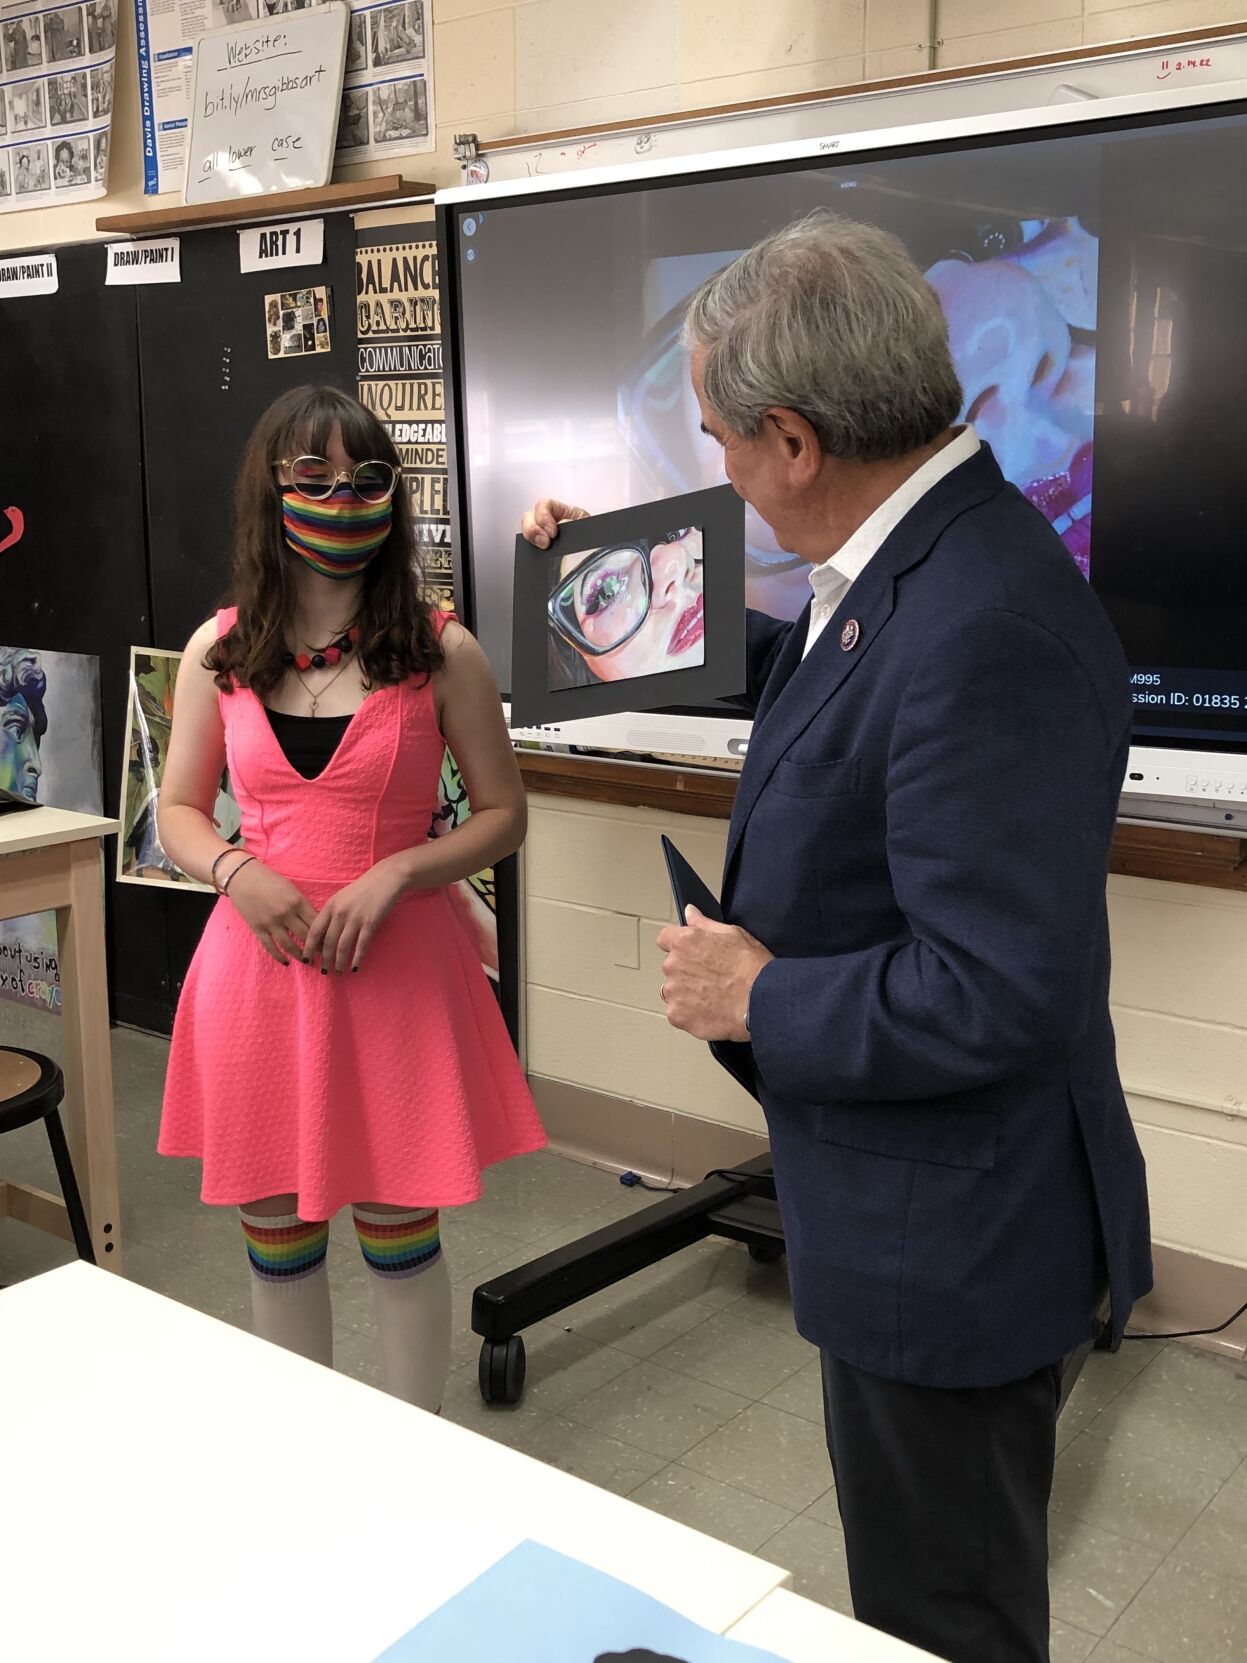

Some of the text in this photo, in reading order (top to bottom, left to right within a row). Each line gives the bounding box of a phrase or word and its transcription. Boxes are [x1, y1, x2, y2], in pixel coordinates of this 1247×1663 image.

[226, 34, 287, 65] Website:
[140, 60, 151, 116] Drawing
[203, 65, 326, 118] bit.ly/mrsgibbsart
[144, 120, 153, 157] Davis
[819, 140, 840, 150] SMART
[202, 151, 219, 173] all
[228, 145, 256, 164] lower
[271, 136, 303, 151] case
[113, 247, 169, 267] DRAW/PAINT
[258, 227, 302, 259] ART 1
[46, 262, 54, 278] II
[357, 295, 441, 336] CARIN
[1170, 692, 1189, 706] ID:
[1193, 693, 1240, 709] 01835
[0, 942, 22, 965] out
